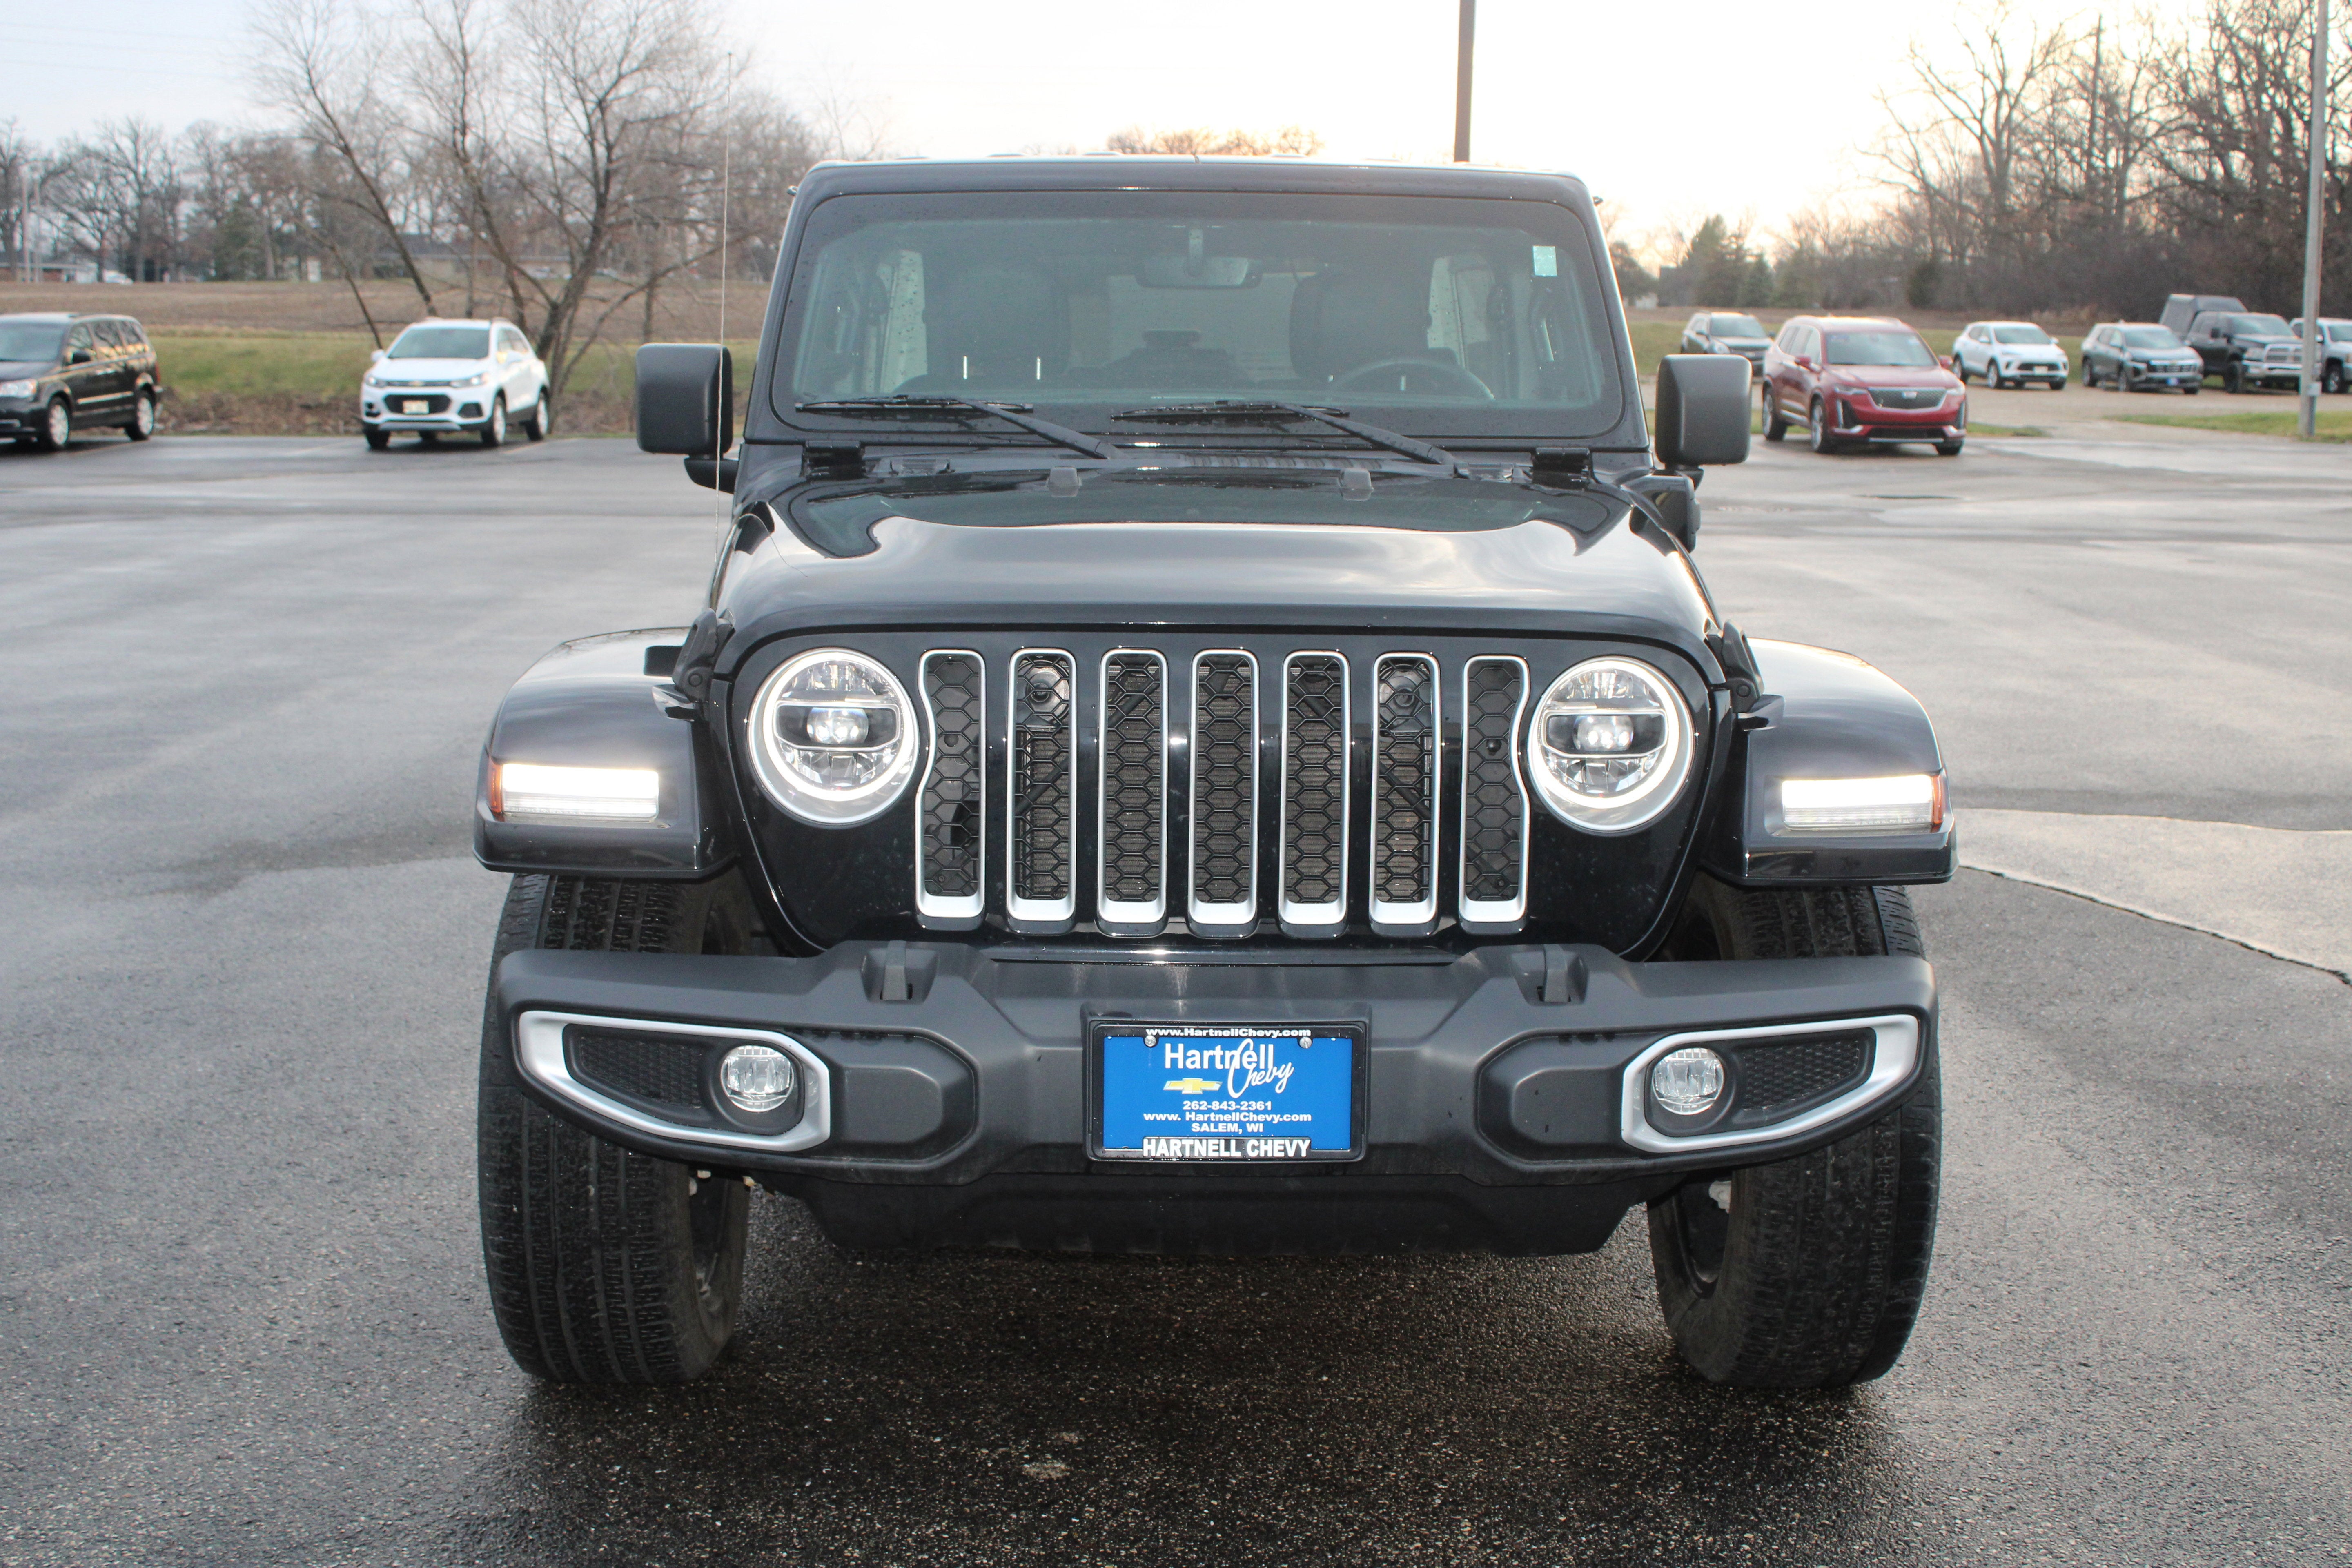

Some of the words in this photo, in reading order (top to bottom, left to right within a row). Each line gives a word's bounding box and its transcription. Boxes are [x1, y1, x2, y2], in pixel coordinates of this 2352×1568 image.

[1146, 1028, 1311, 1038] www.HartnellChevy.com
[1165, 1043, 1274, 1069] Hartnell
[1227, 1038, 1294, 1098] Chevy
[1183, 1101, 1272, 1110] 262-843-2361
[1192, 1123, 1242, 1134] SALEM,
[1246, 1123, 1263, 1132] WI
[1143, 1139, 1241, 1157] HARTNELL
[1247, 1139, 1311, 1157] CHEVY
